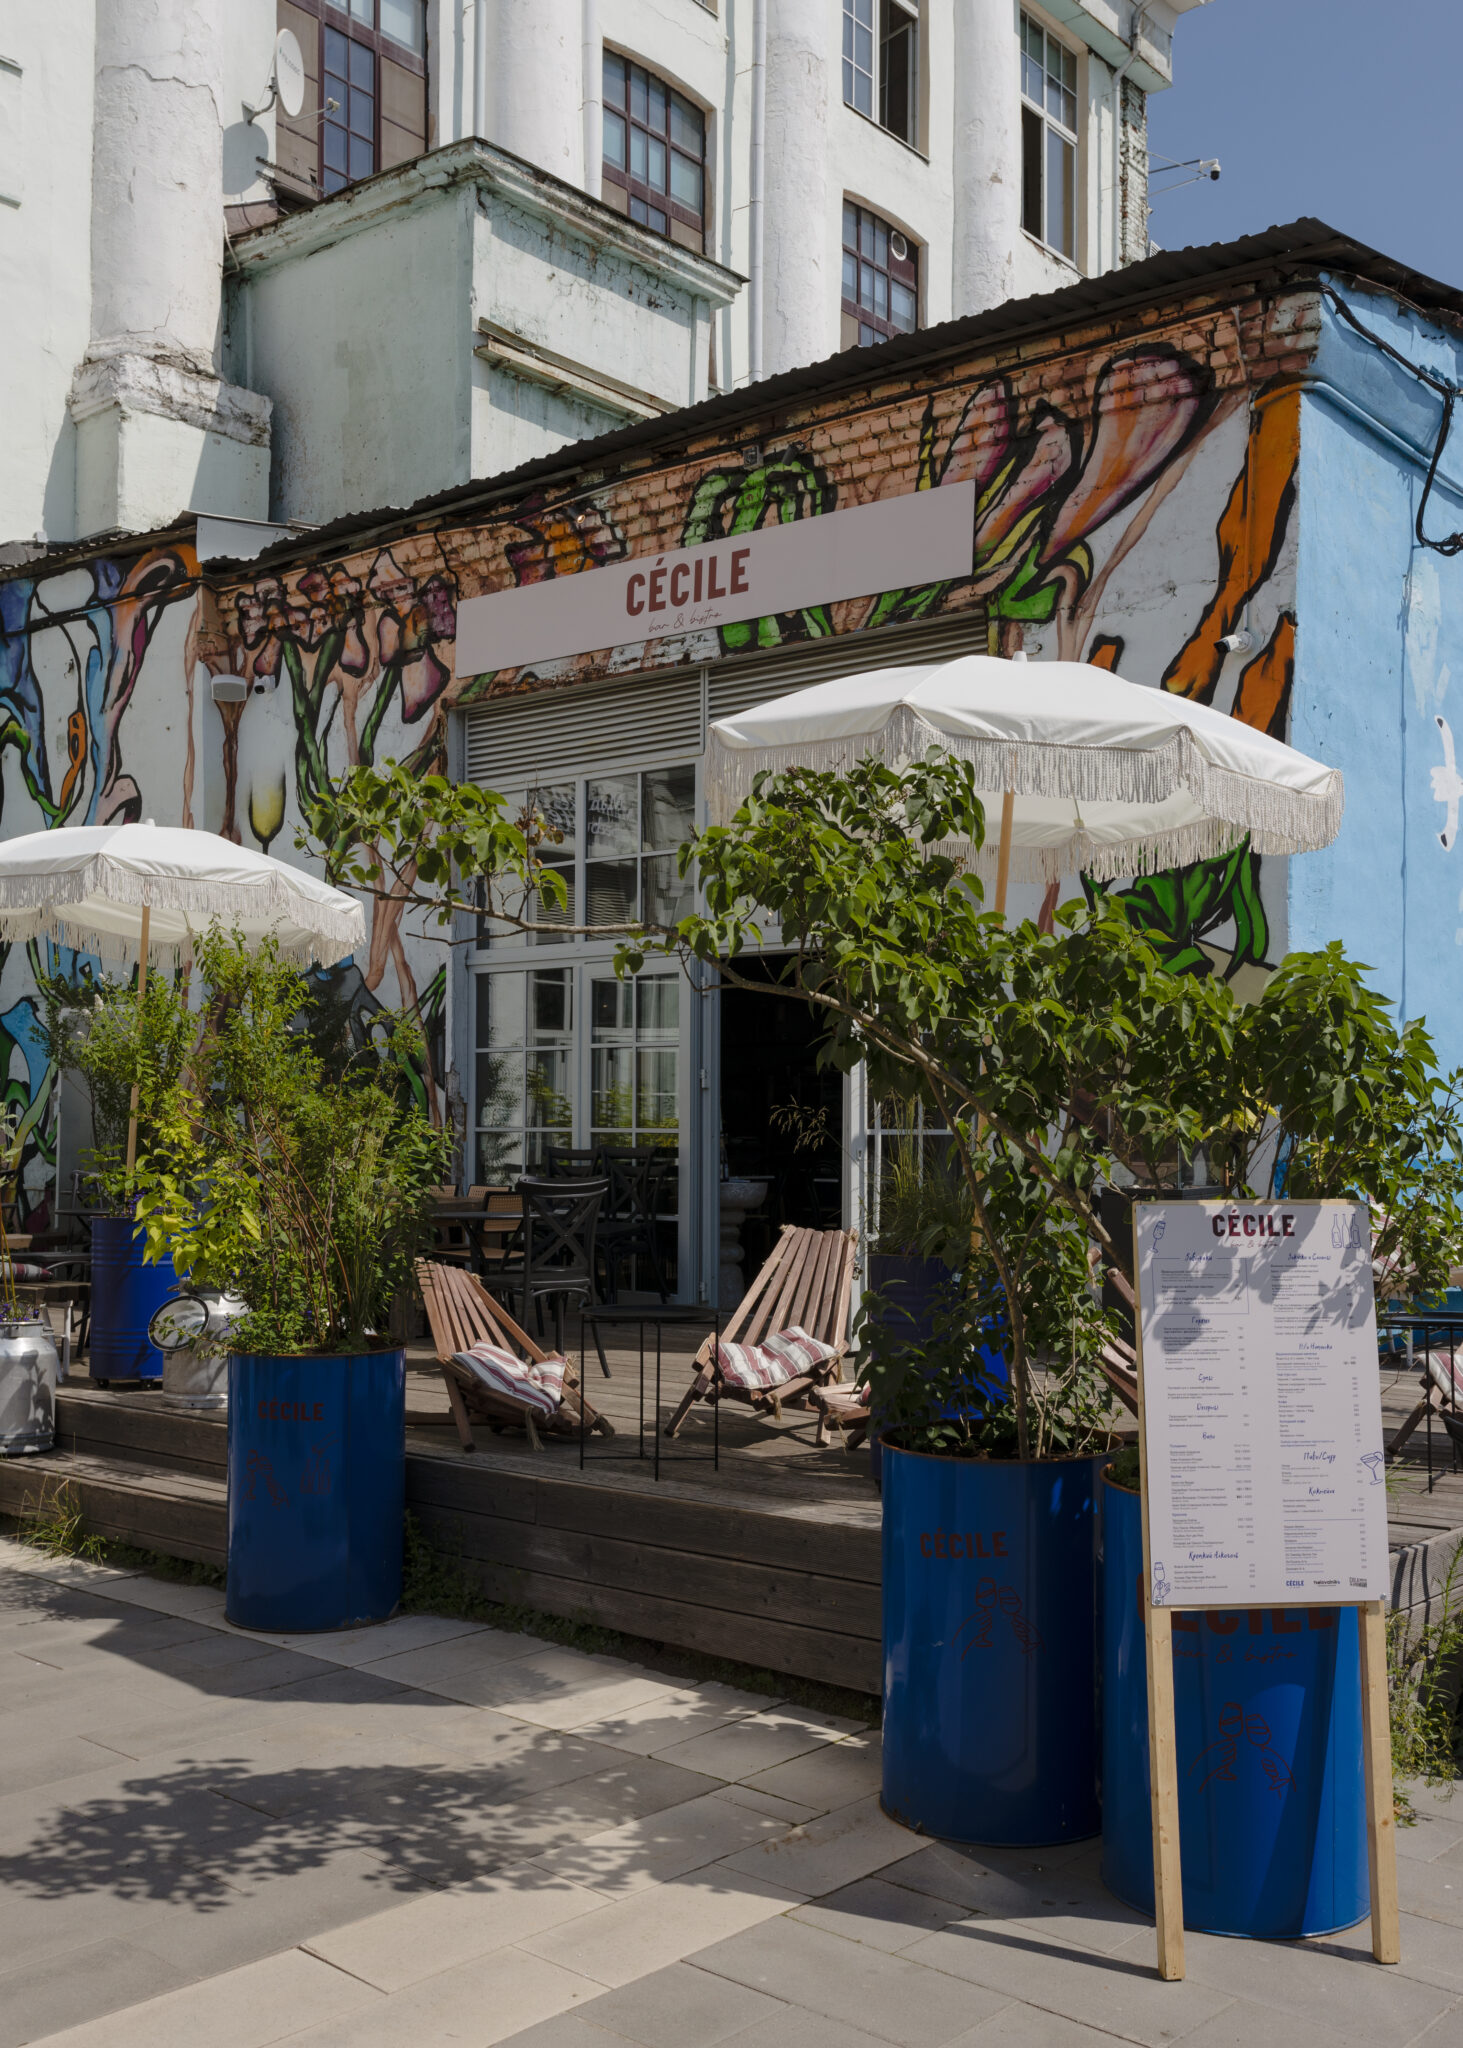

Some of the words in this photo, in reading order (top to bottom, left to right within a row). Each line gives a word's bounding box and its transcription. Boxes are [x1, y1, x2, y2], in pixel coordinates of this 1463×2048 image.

[626, 547, 751, 617] CÉCILE
[648, 617, 670, 633] bar
[673, 612, 684, 629] &
[1212, 1209, 1295, 1237] CÉCILE
[257, 1396, 325, 1421] CÉCILE
[920, 1526, 1009, 1559] CÉCILE
[1215, 1643, 1233, 1664] &
